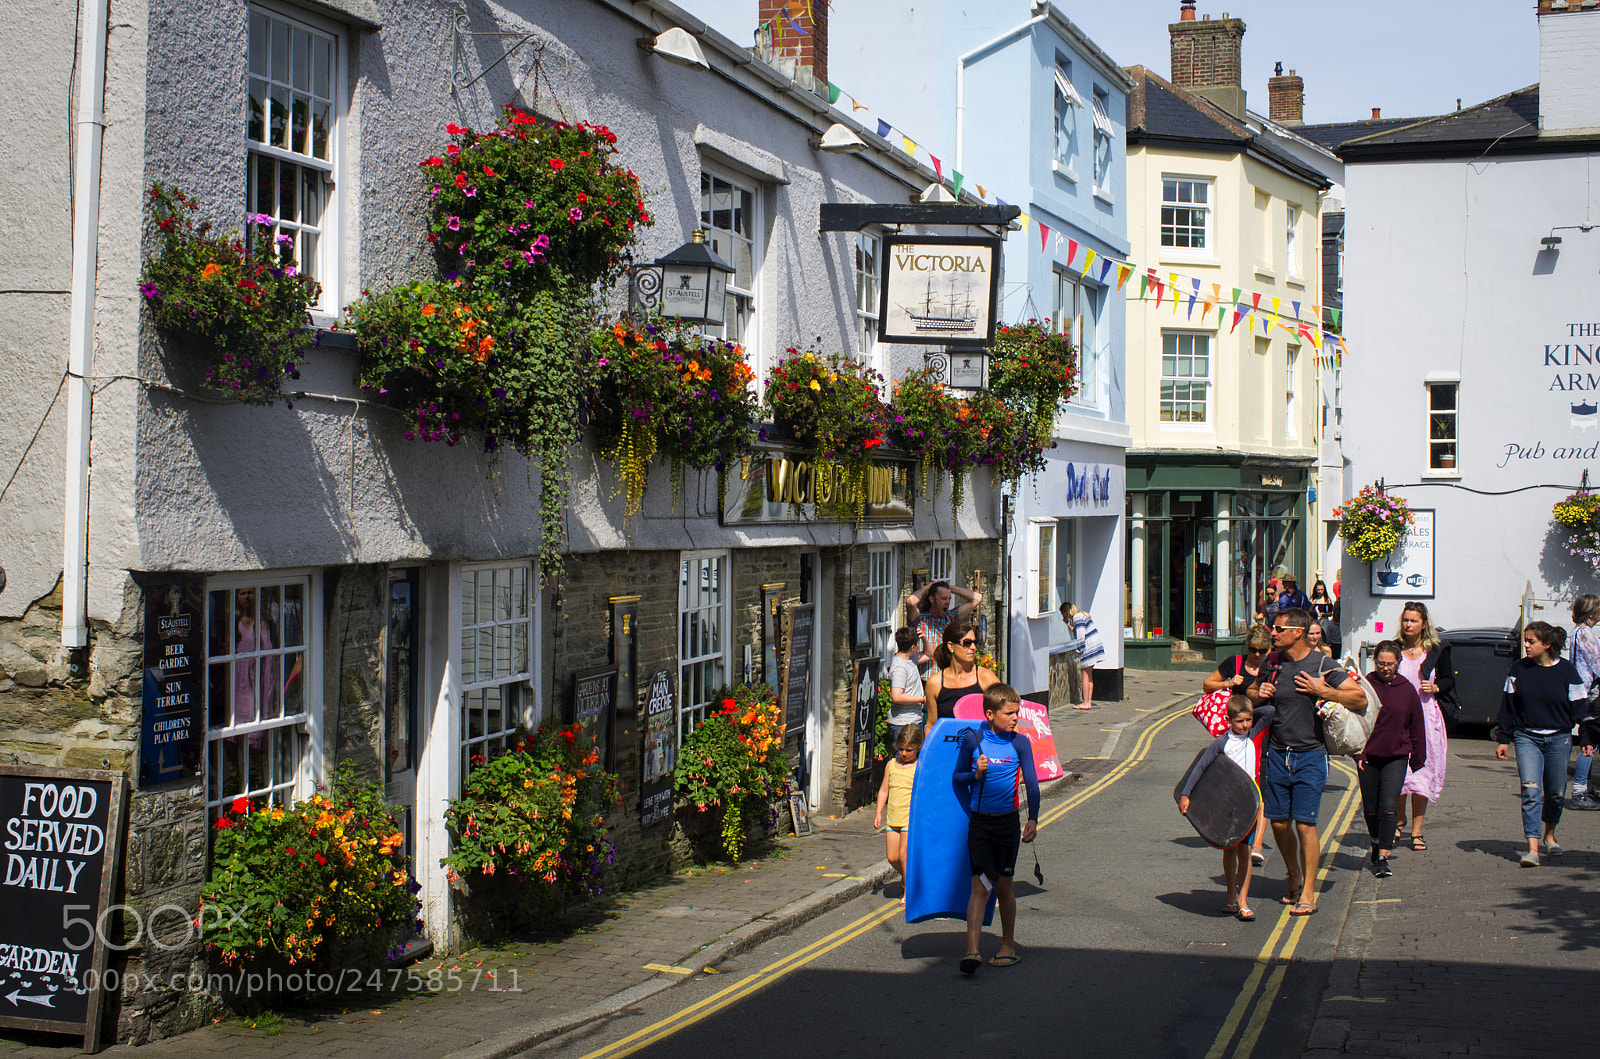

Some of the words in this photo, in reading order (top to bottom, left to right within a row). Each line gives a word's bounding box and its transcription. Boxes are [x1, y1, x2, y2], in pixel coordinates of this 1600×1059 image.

[896, 245, 914, 253] THE
[895, 255, 986, 272] VICTORIA
[1543, 344, 1600, 366] KIN
[1496, 441, 1545, 468] Pub
[1552, 441, 1600, 459] and
[867, 465, 893, 504] INN
[1396, 541, 1430, 549] ERRACE
[1196, 627, 1212, 635] SALE
[165, 644, 185, 656] BEER
[159, 656, 190, 670] GARDEN
[656, 670, 668, 682] THE
[165, 681, 181, 693] SUN
[652, 680, 669, 698] MAN
[156, 693, 190, 708] TERRACE
[648, 693, 673, 715] CRECHE
[153, 717, 191, 732] CHILDREN'S
[154, 733, 171, 744] PLAY
[171, 729, 190, 741] AREA
[20, 782, 98, 818] FOOD
[4, 817, 104, 855] SERVED
[2, 853, 87, 894] DAILY
[0, 943, 80, 976] GARDEN
